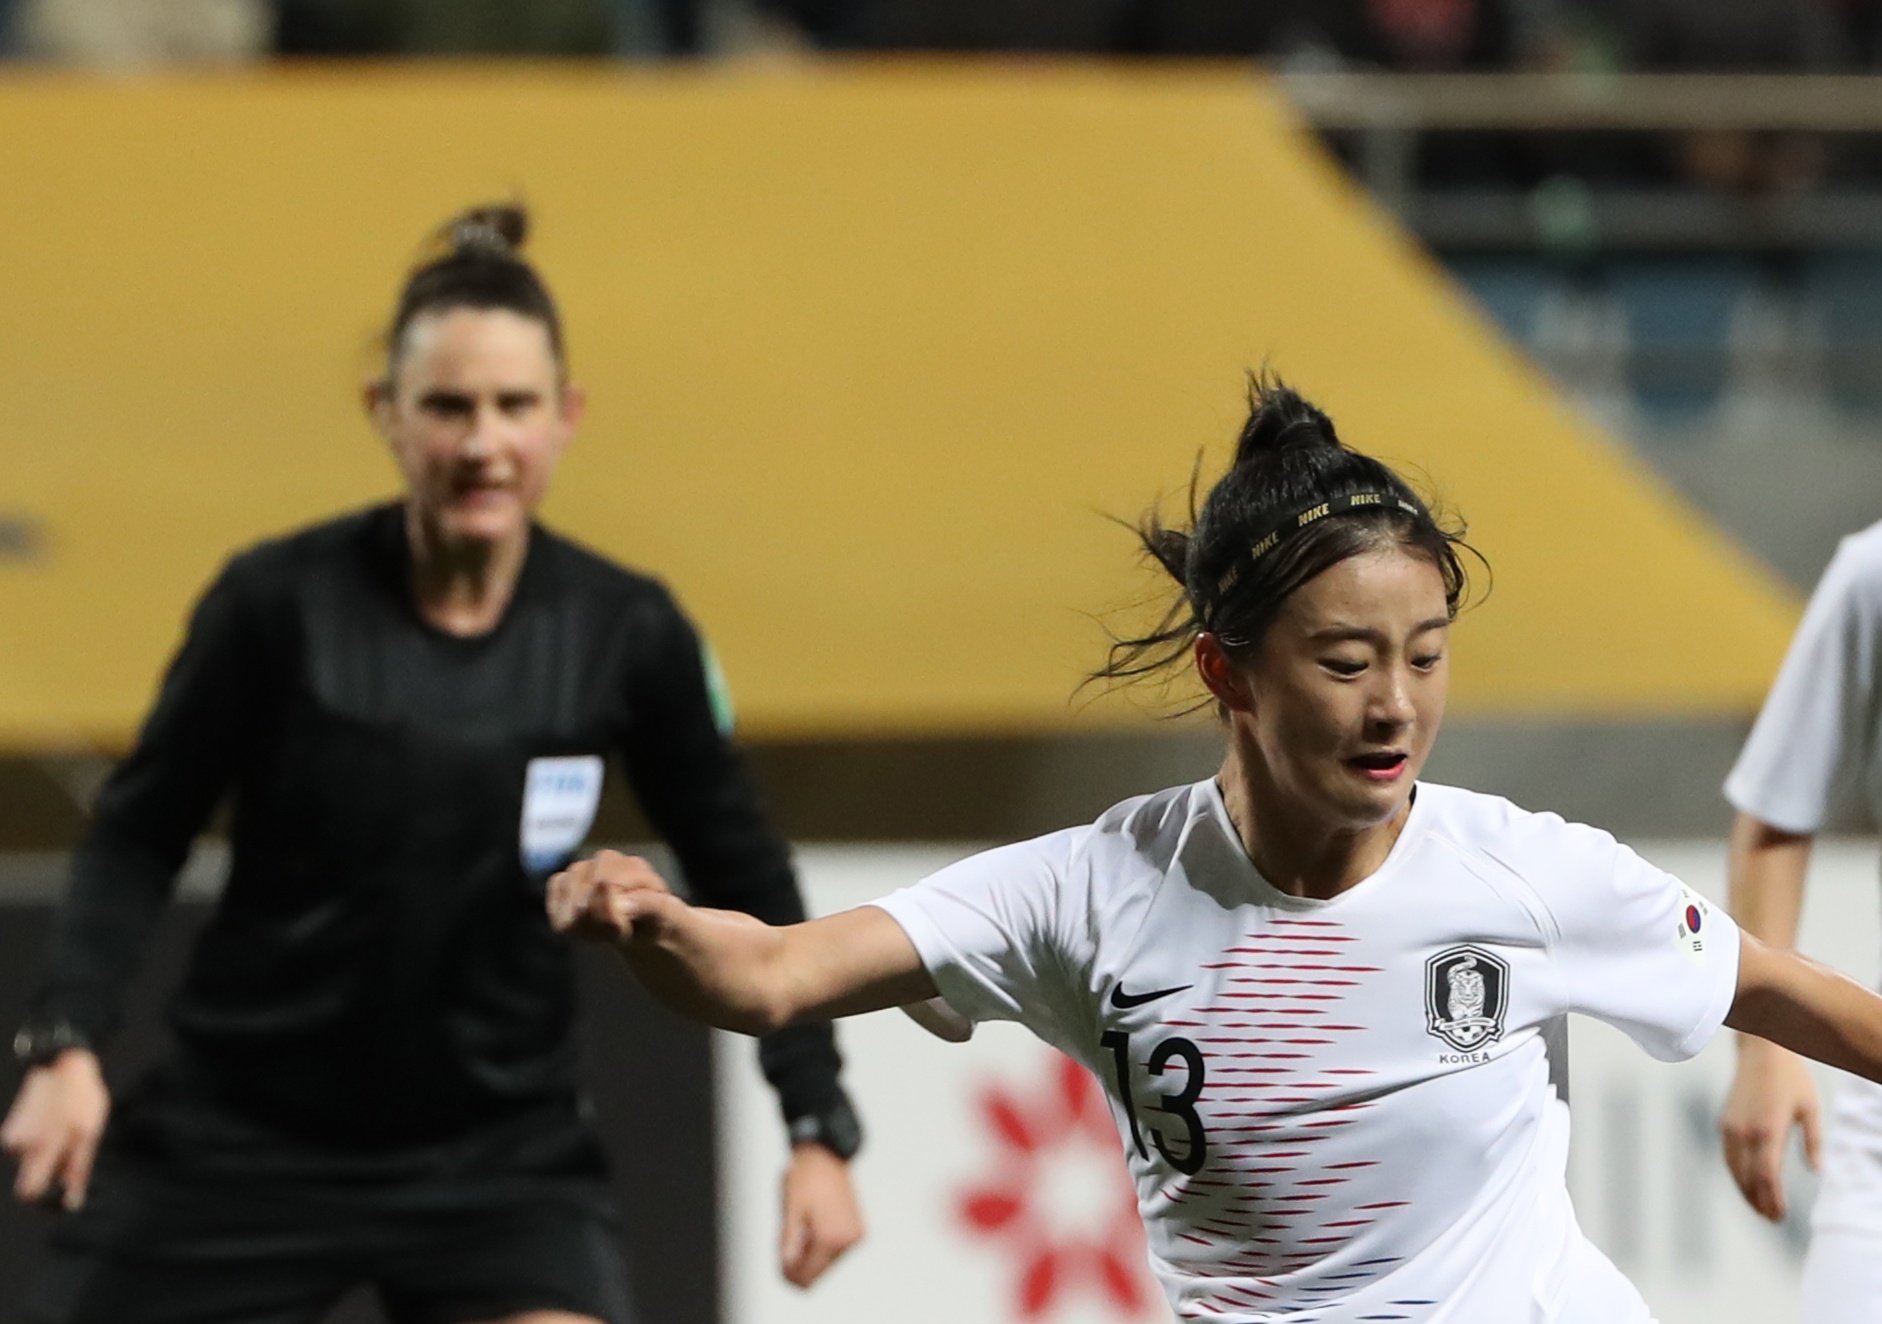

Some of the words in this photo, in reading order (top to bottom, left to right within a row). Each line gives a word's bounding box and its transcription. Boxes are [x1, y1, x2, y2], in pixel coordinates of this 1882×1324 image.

[1252, 531, 1279, 559] NIKE
[1299, 503, 1330, 526] NIKE
[1351, 494, 1381, 505] NIKE
[1439, 1051, 1491, 1065] KOREA
[1100, 1030, 1206, 1176] 13
